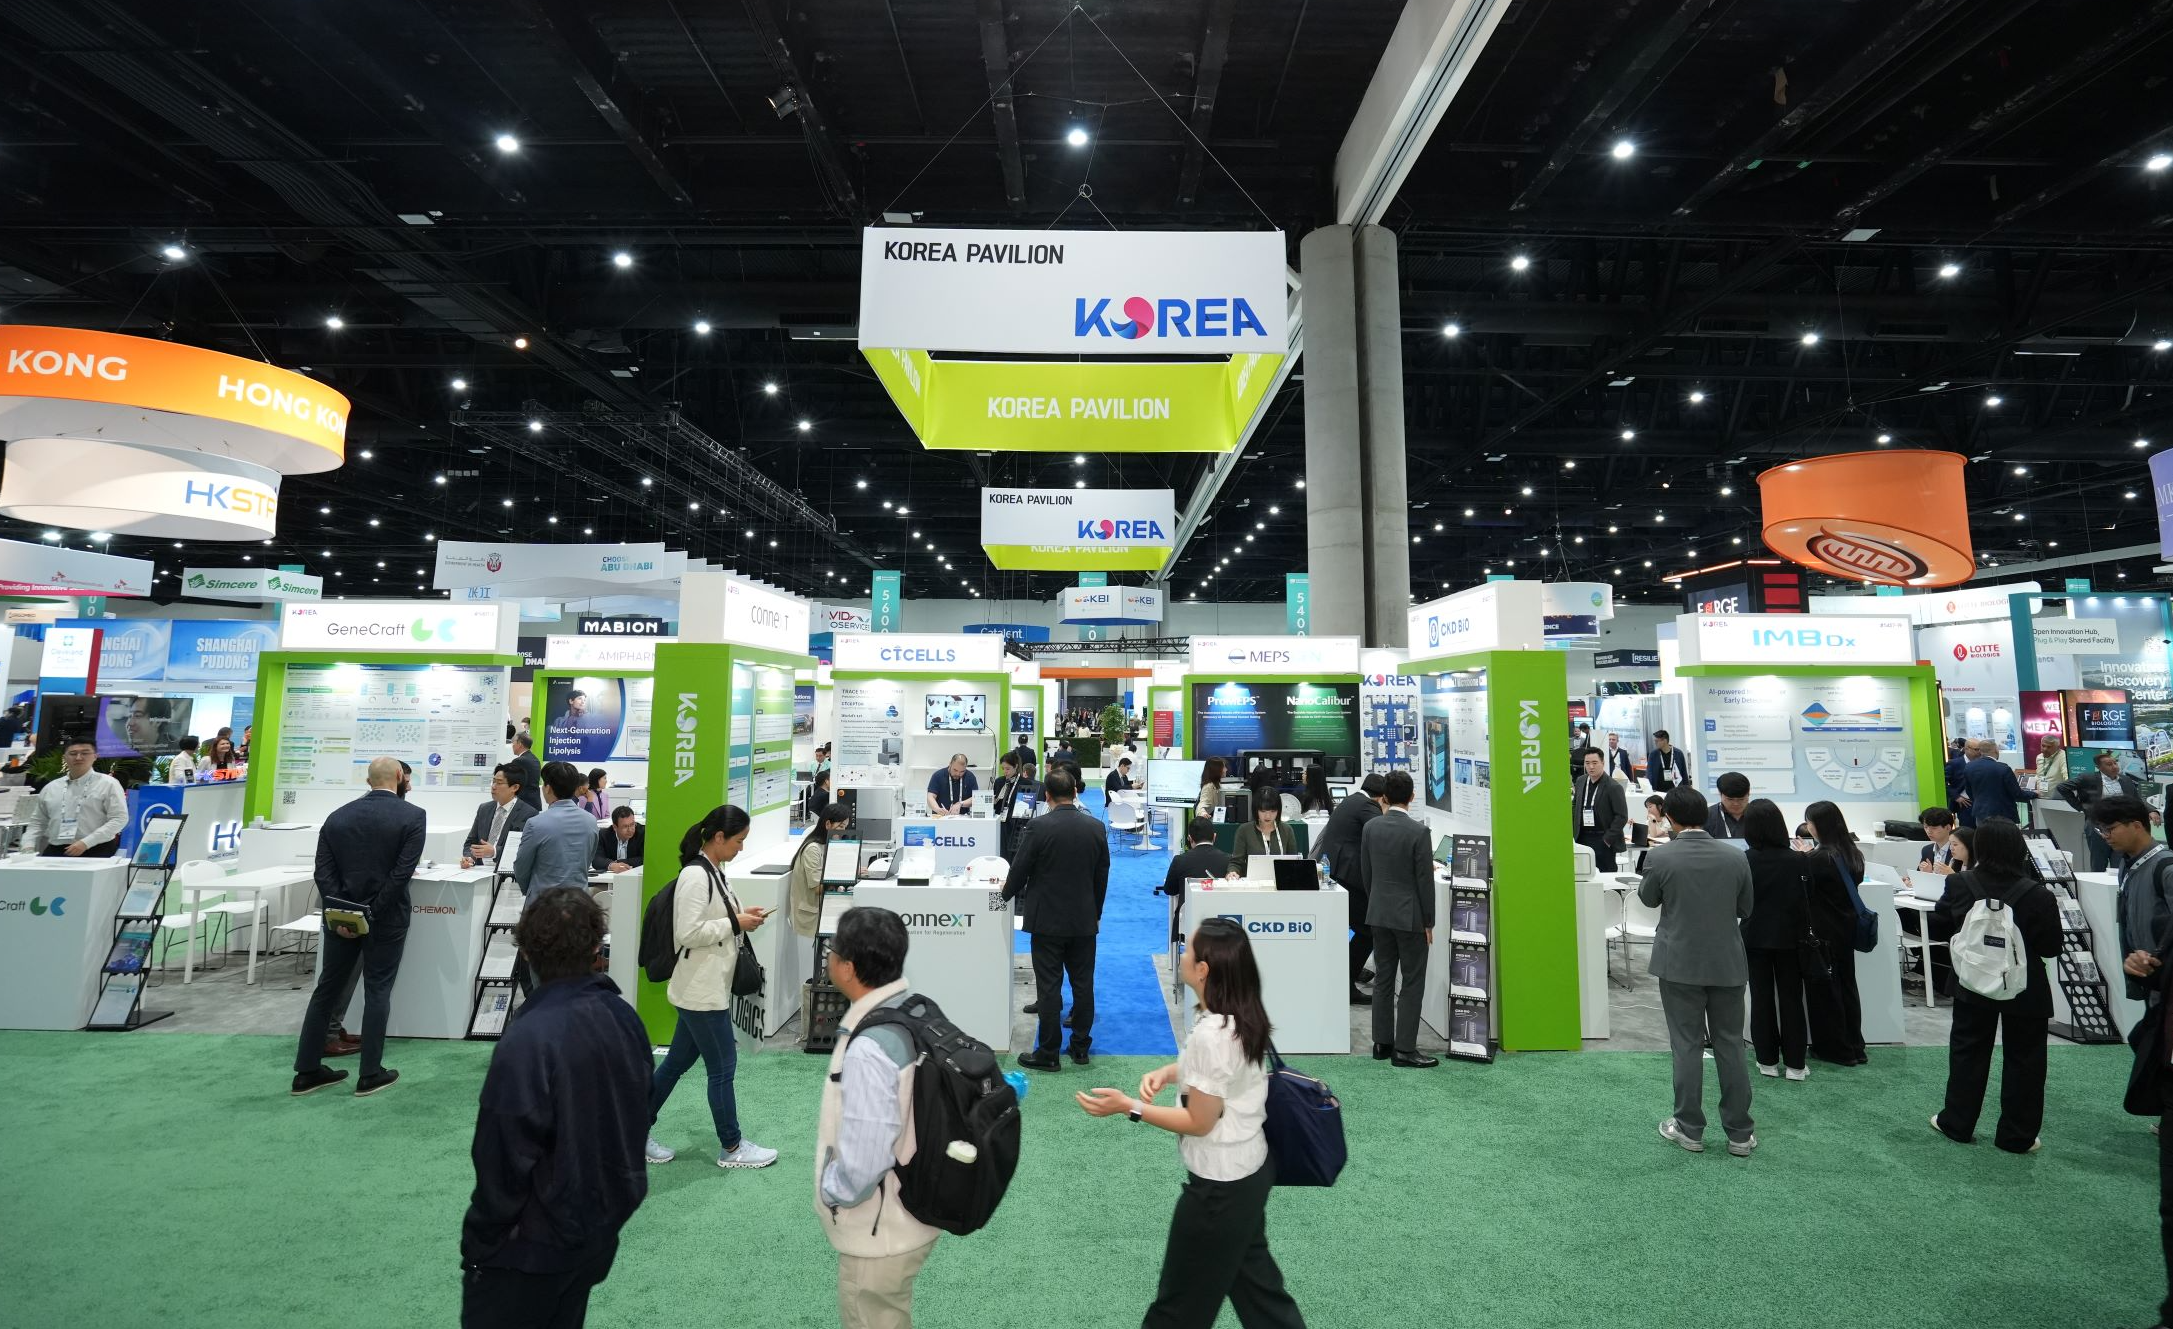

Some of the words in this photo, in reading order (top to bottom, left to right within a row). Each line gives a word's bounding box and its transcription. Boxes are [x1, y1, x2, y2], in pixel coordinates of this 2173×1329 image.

[884, 241, 957, 263] KOREA
[966, 244, 1064, 265] PAVILION
[1074, 296, 1267, 339] KOREA
[7, 349, 129, 381] KONG
[217, 375, 311, 420] HONG
[987, 397, 1061, 419] KOREA
[1070, 397, 1169, 420] PAVILION
[989, 494, 1023, 504] KOREA
[1027, 494, 1073, 506] PAVILION
[1078, 519, 1165, 540] KOREA
[600, 562, 621, 571] ABU
[622, 562, 653, 571] DHABI
[205, 579, 258, 589] Simcere
[281, 582, 319, 596] Simcere
[1139, 596, 1155, 605] KBI
[751, 604, 789, 631] conneT
[829, 611, 850, 621] VID
[327, 623, 405, 636] GeneCraft
[584, 620, 658, 633] MABION
[1441, 621, 1457, 636] CKD
[101, 637, 141, 651] NGHAI
[196, 637, 258, 653] SHANGHAI
[1970, 644, 2000, 653] LOTTE
[200, 655, 250, 669] PUDONG
[598, 651, 655, 662] AMIPHAR
[1362, 674, 1416, 687] KOREA
[2104, 675, 2167, 689] Discovery
[550, 726, 611, 735] Next-Generation
[549, 737, 581, 745] Injection
[674, 693, 698, 787] KOREA
[1519, 700, 1542, 794] KOREA
[549, 747, 581, 755] Lipolysis
[1248, 921, 1285, 933] CKD
